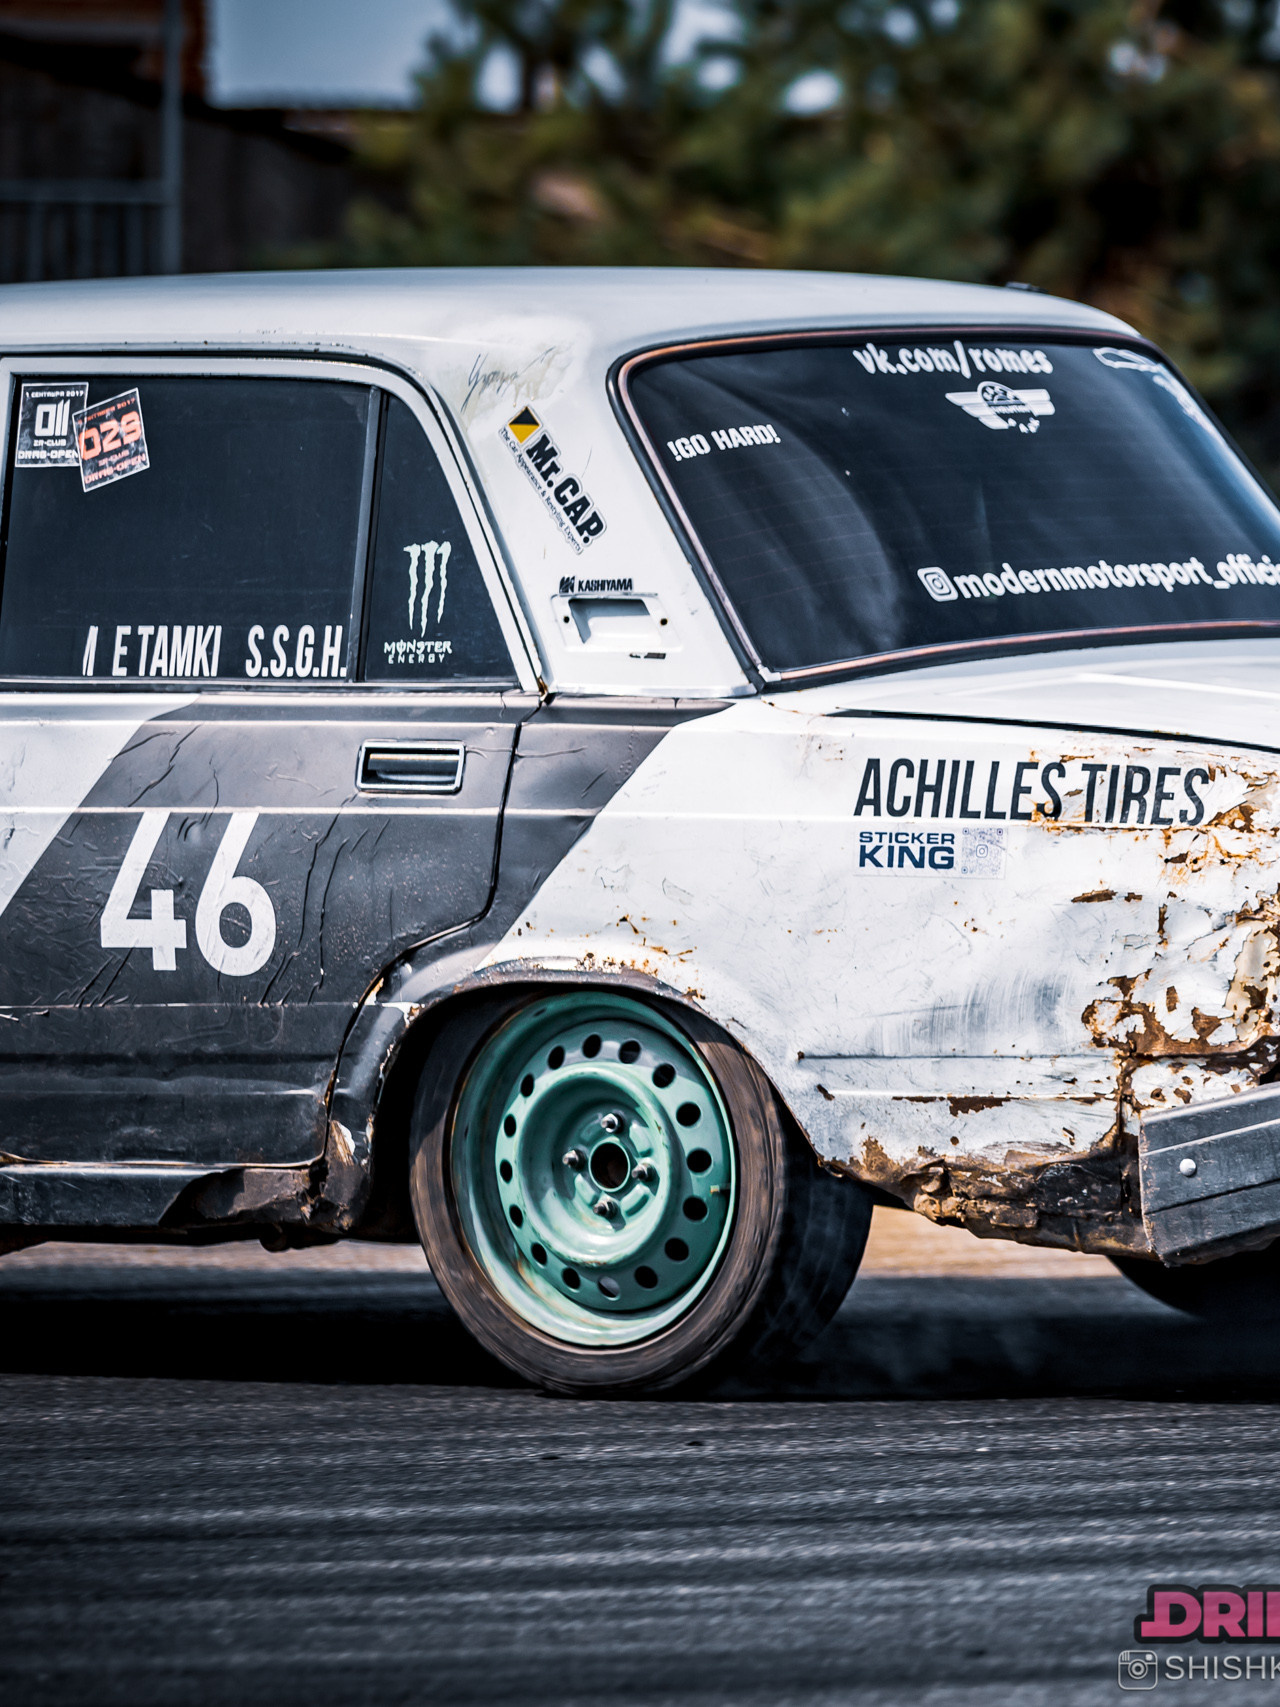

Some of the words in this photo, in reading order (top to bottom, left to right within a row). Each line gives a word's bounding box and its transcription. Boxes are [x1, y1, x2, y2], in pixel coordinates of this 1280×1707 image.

[853, 340, 1053, 379] vk.com/romes
[78, 411, 141, 460] 029
[711, 424, 781, 451] HARD!
[526, 433, 561, 488] Mr.
[578, 578, 633, 592] KASHIYAMA
[245, 625, 347, 678] S.S.G.H.
[384, 639, 452, 656] MONSTER
[388, 653, 445, 664] ENERGY
[853, 758, 1066, 821] ACHILLES
[1081, 763, 1210, 826] TIRES
[859, 831, 955, 845] STICKER
[859, 845, 955, 870] KING
[101, 812, 276, 977] 46
